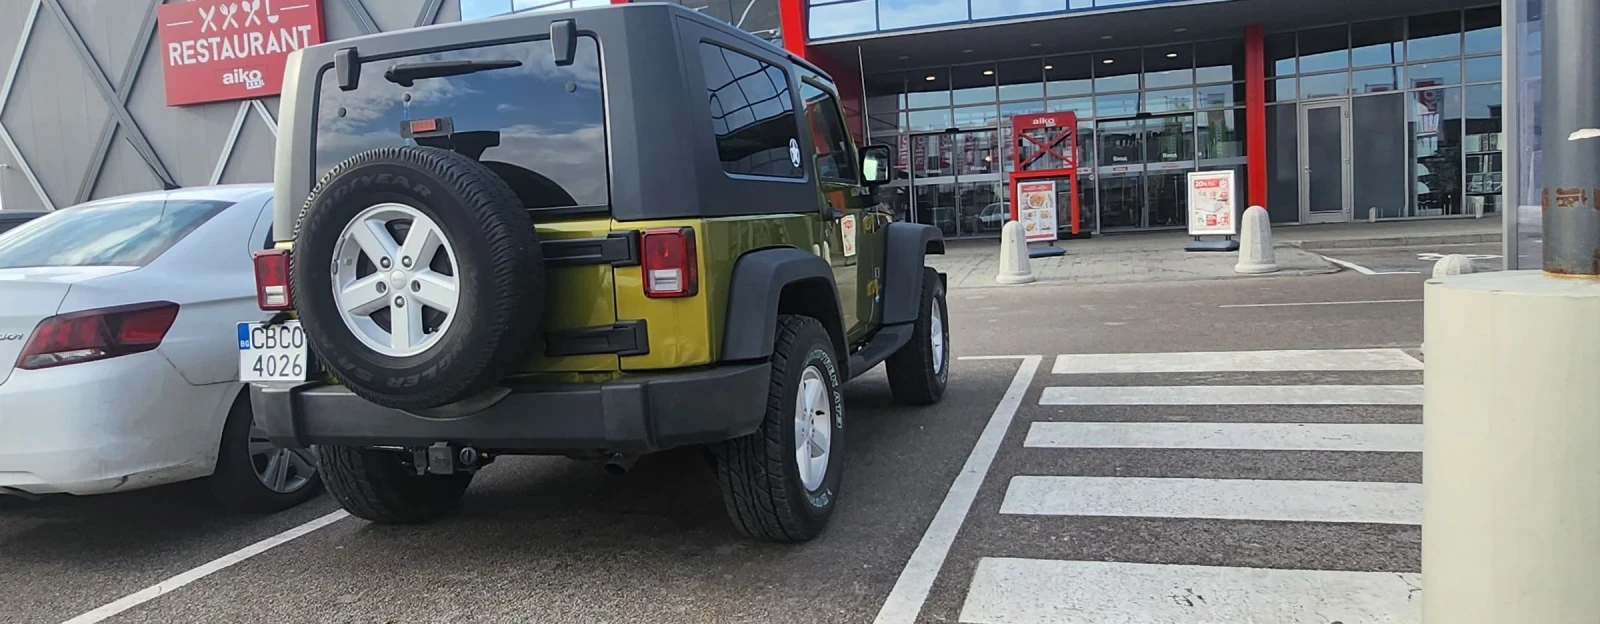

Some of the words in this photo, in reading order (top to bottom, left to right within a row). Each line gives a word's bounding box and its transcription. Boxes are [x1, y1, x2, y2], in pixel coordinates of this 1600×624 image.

[168, 24, 312, 67] RESTAURANT
[222, 68, 262, 85] aiko
[1032, 117, 1055, 125] aiko
[240, 340, 250, 348] BG
[253, 354, 302, 377] 4026
